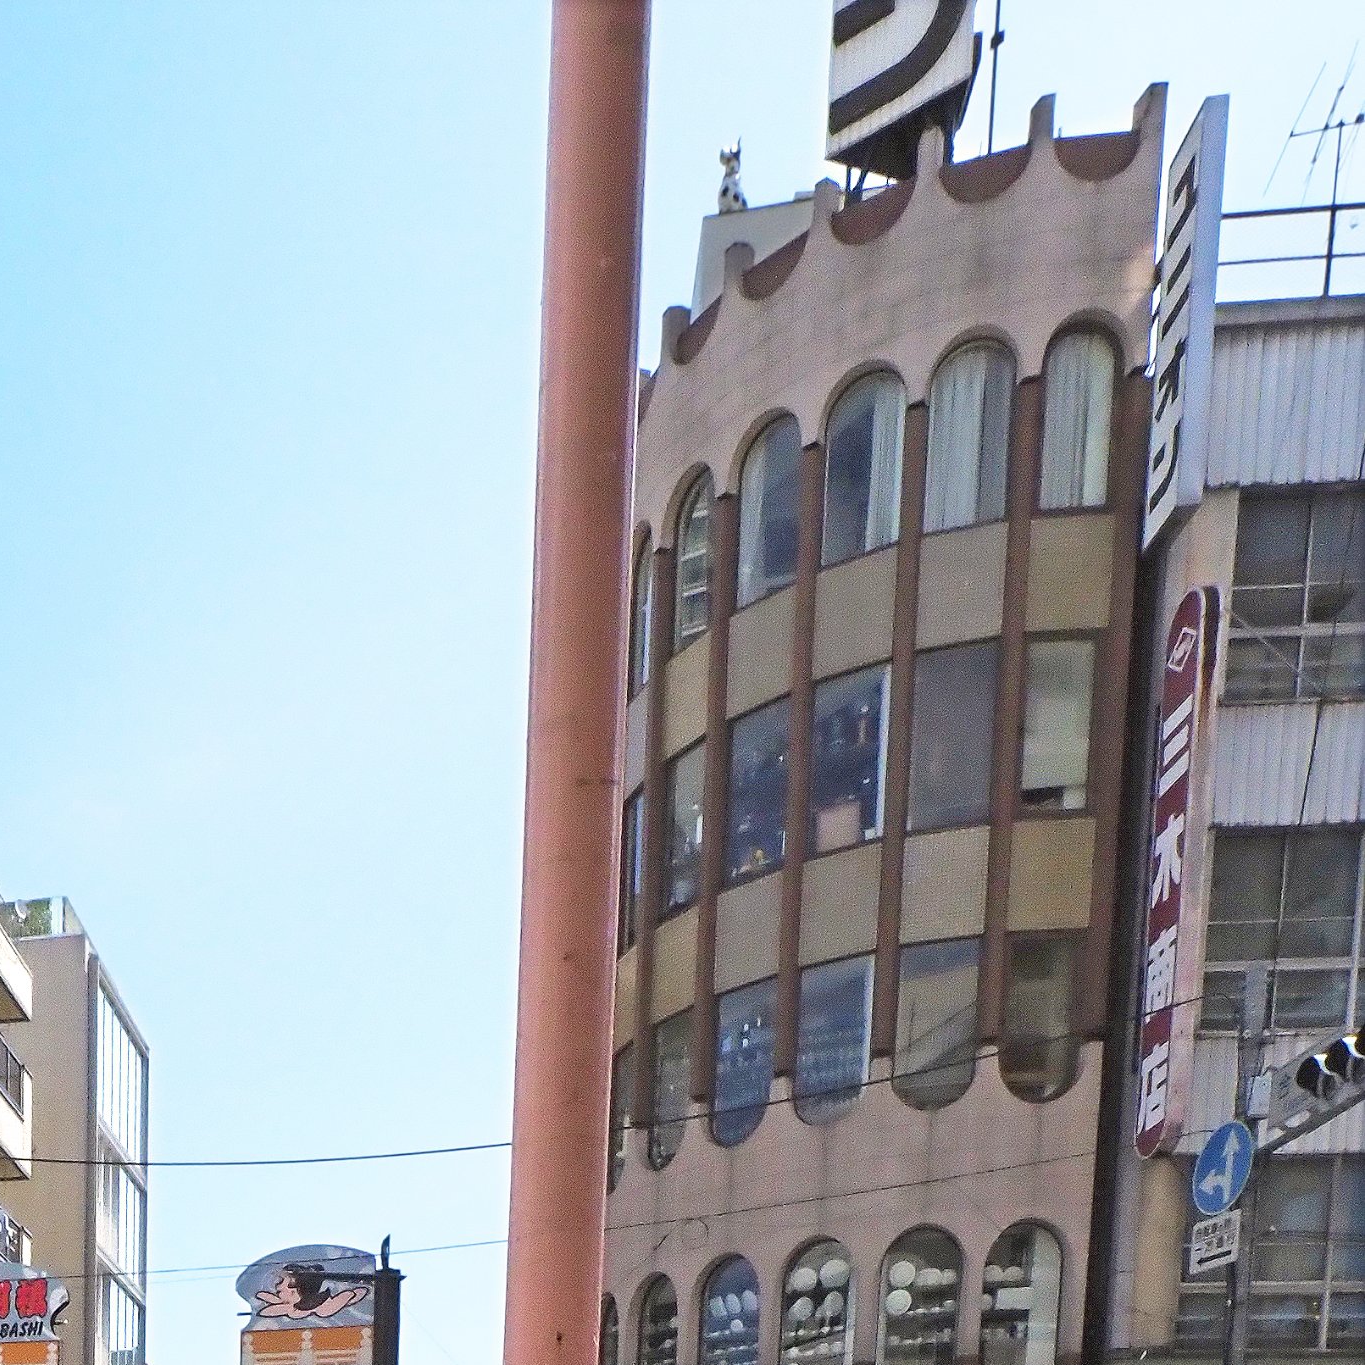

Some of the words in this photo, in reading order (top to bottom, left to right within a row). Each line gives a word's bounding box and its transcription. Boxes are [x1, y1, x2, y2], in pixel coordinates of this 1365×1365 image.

[1148, 154, 1197, 517] ユニオン
[1137, 693, 1194, 1135] 三木商店
